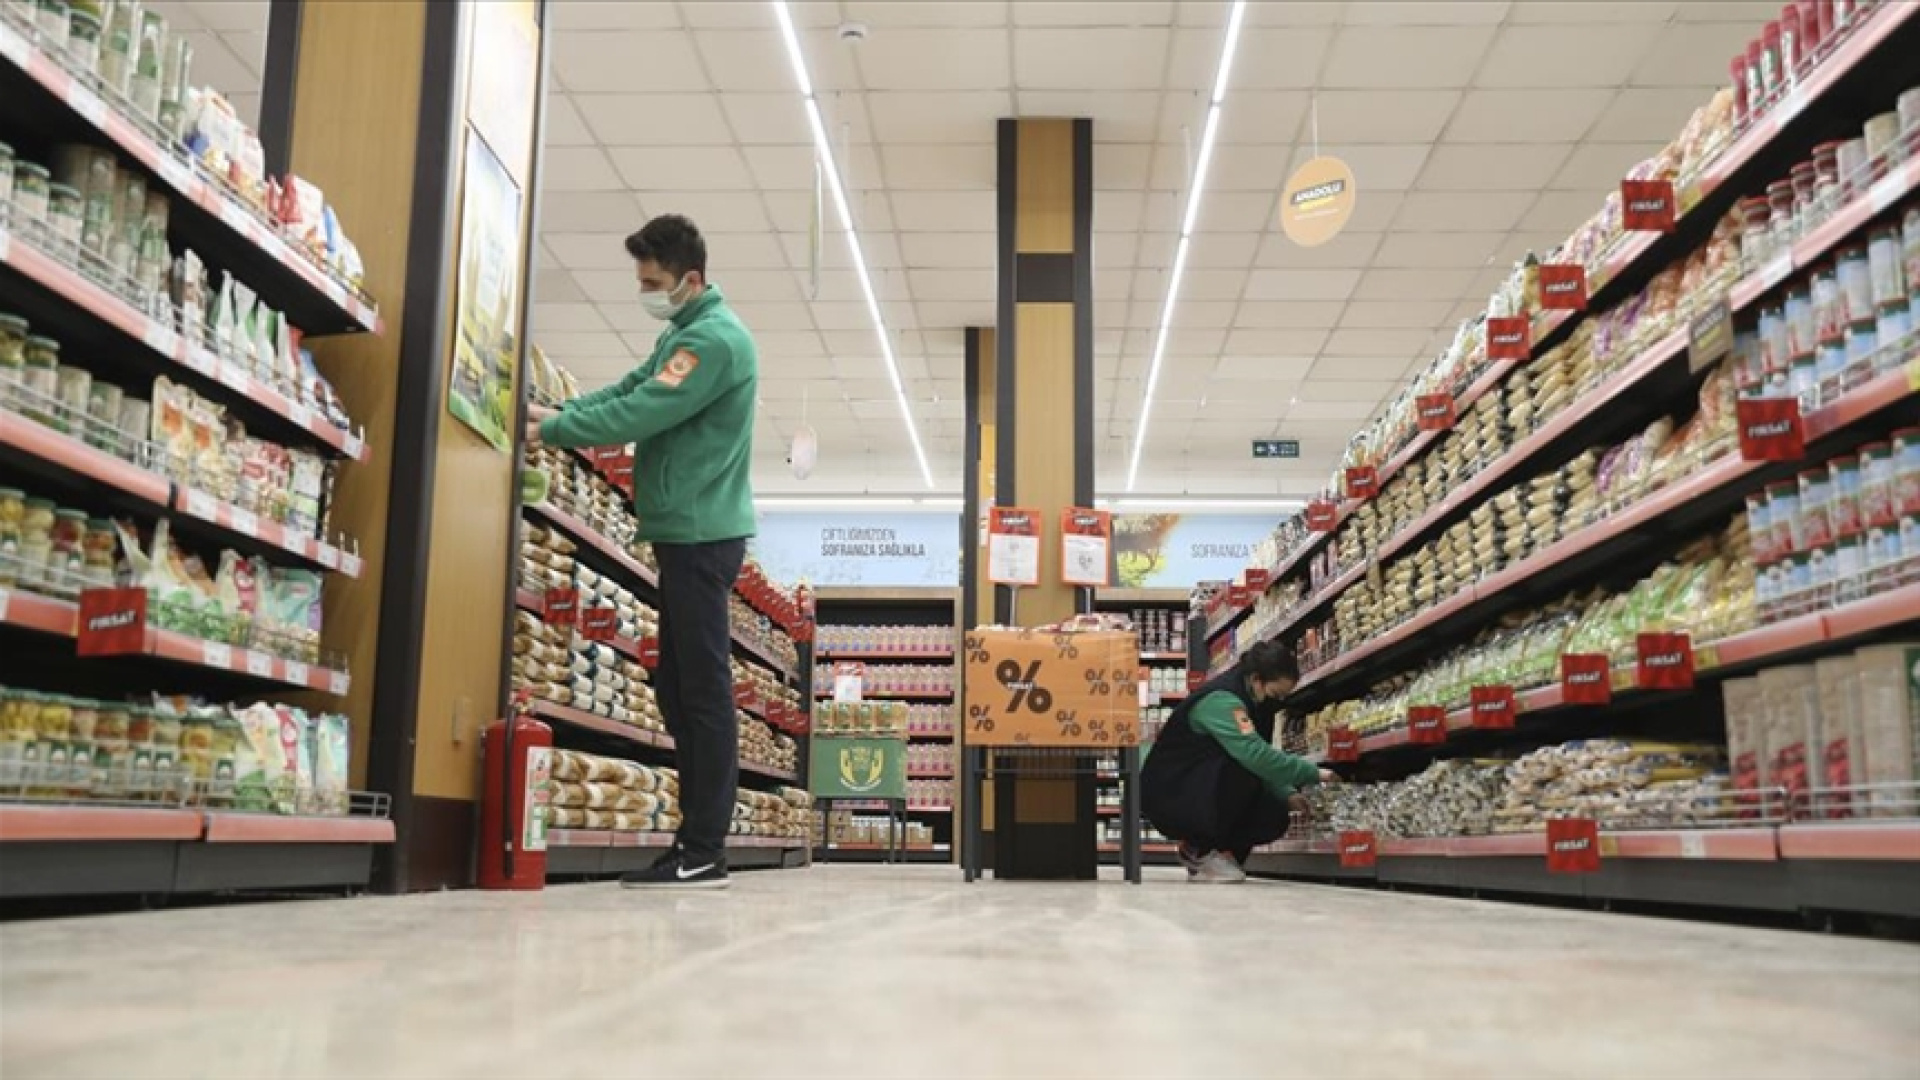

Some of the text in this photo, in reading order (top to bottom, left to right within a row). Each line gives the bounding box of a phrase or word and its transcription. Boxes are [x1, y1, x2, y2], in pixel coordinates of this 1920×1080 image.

[1748, 419, 1790, 437] FIRSAT
[88, 611, 135, 630] FIRSAT
[1645, 652, 1682, 666] FIRSAT
[1567, 670, 1601, 683] FIRSAT
[1554, 837, 1589, 853] FIRSAT
